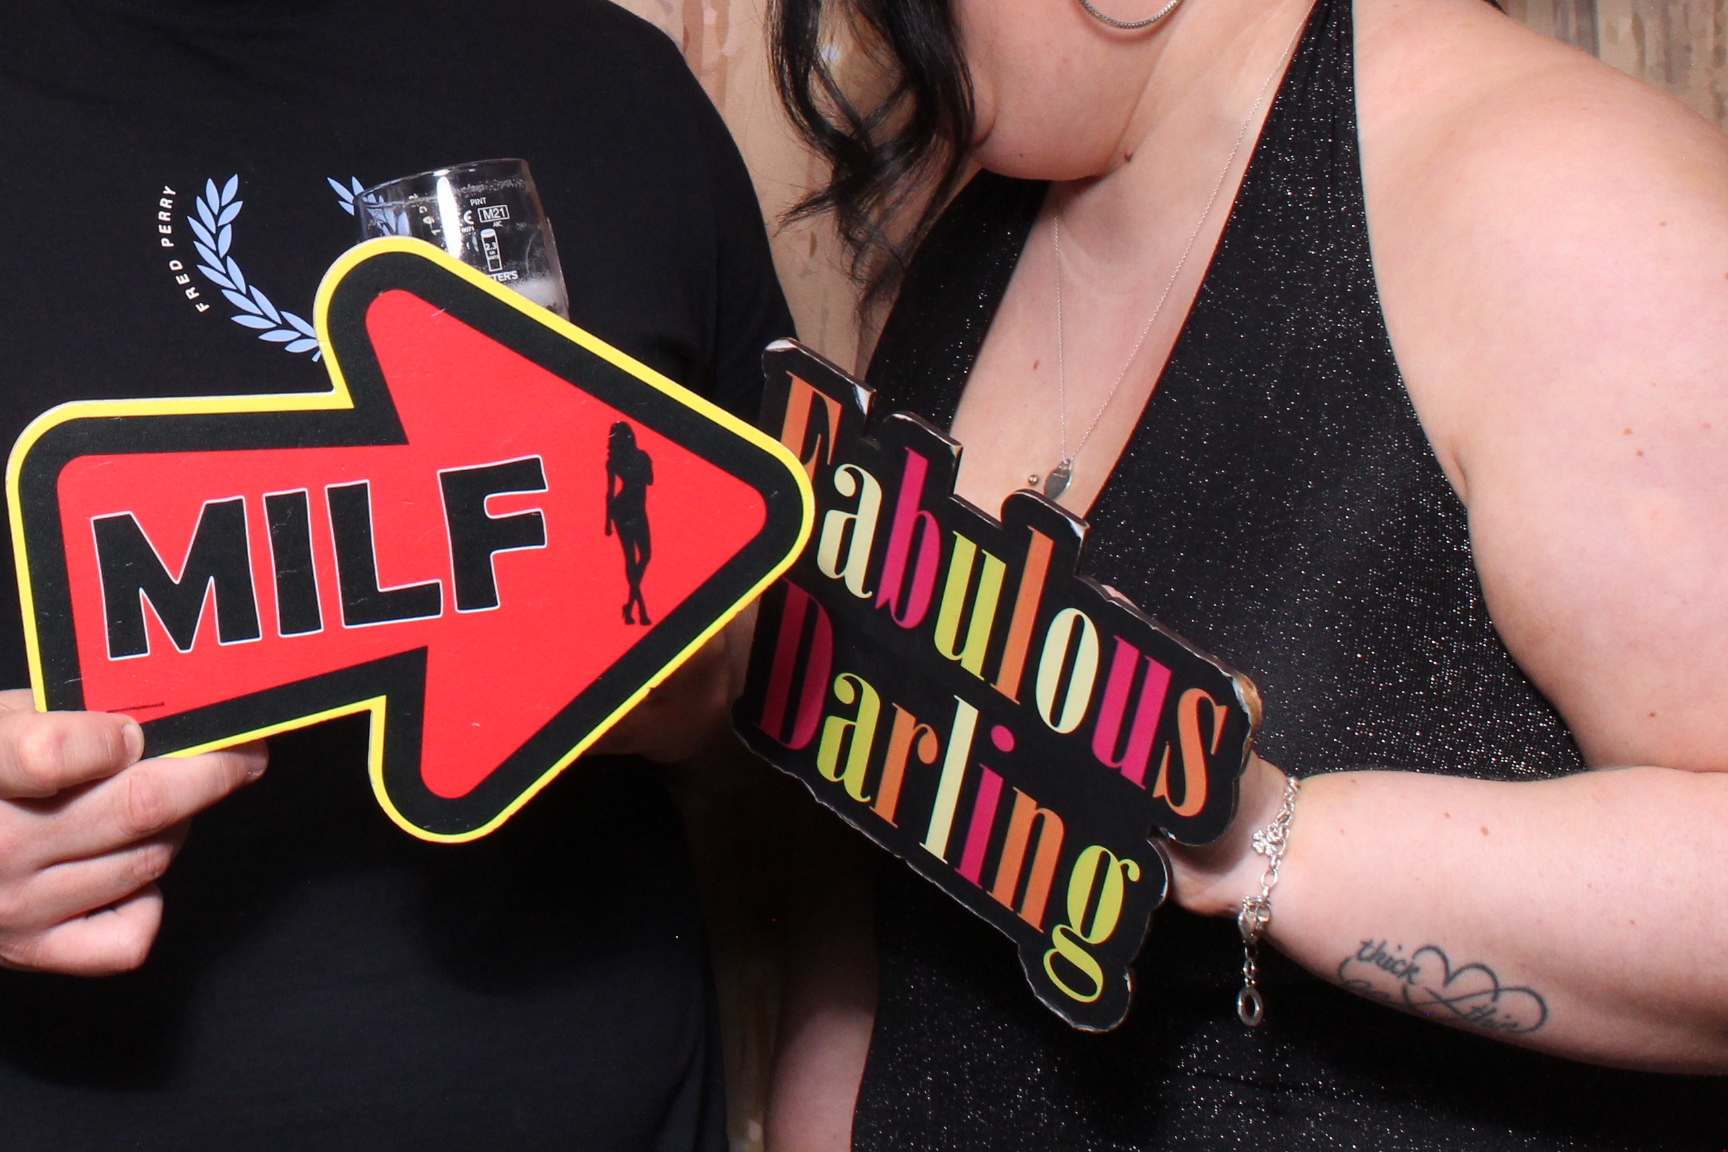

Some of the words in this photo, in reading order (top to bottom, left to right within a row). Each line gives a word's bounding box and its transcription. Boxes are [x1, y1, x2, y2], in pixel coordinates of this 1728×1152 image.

[158, 185, 177, 247] PERRY
[470, 196, 487, 206] PINT
[482, 207, 507, 221] M21
[483, 242, 498, 251] 2.3
[169, 259, 211, 312] FRED
[489, 270, 519, 282] TER'S
[90, 455, 548, 661] MILF
[786, 371, 1228, 818] Fabulous
[756, 578, 1141, 1004] Darling
